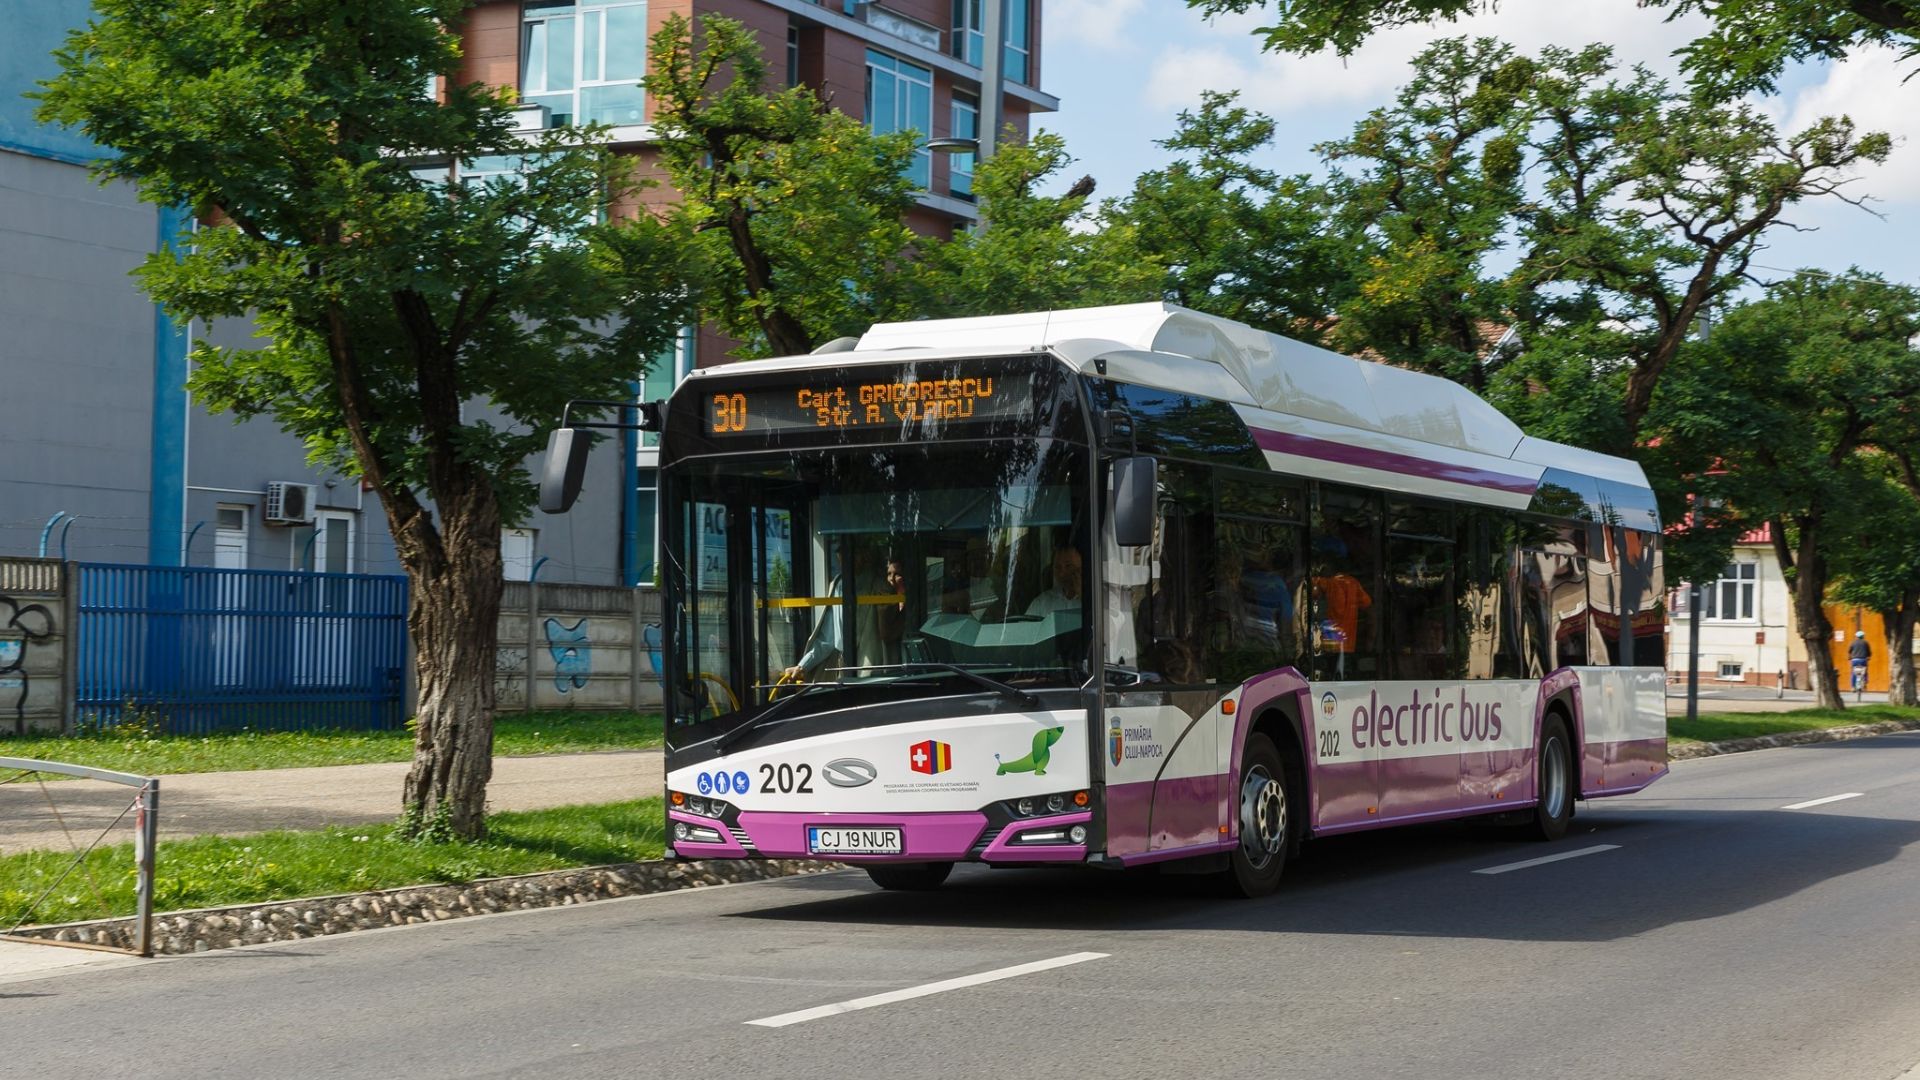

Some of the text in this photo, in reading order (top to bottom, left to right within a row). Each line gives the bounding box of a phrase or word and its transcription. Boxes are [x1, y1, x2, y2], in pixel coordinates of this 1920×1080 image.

[798, 377, 993, 408] Cart. GRIGORESCU
[712, 393, 746, 433] 30
[816, 399, 973, 427] Str. A. VLAICU
[1352, 687, 1502, 749] electric bus
[1125, 744, 1163, 759] CLUJ-NAPOCA
[1320, 730, 1340, 757] 202
[759, 763, 814, 794] 202
[821, 831, 840, 847] CJ
[846, 831, 860, 847] 19
[863, 831, 896, 848] NUR
